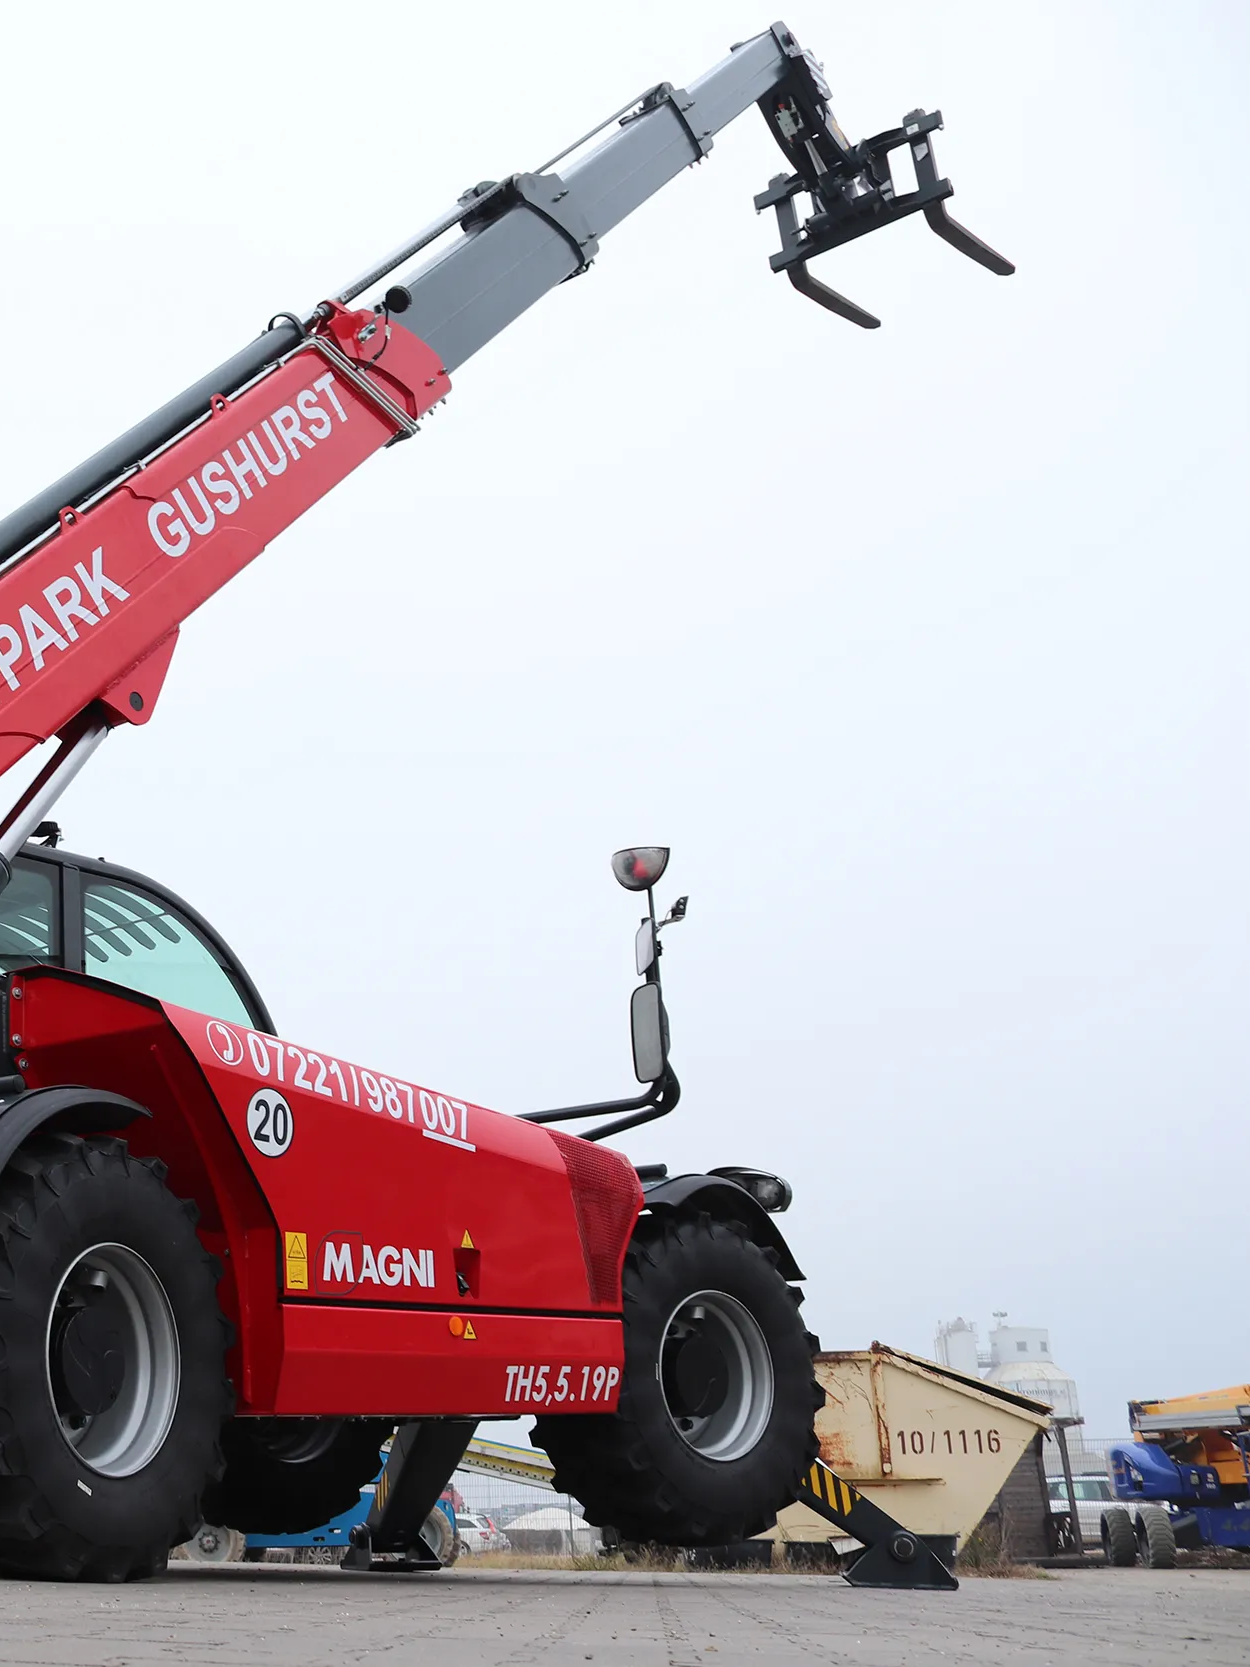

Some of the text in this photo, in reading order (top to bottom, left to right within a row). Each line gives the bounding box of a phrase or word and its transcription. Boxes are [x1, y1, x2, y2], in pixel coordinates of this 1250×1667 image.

[147, 372, 349, 557] GUSHURST
[254, 1099, 288, 1146] 20
[323, 1242, 435, 1288] MAGNI
[505, 1366, 620, 1407] TH5,5.19P
[897, 1429, 1001, 1455] 10/1116
